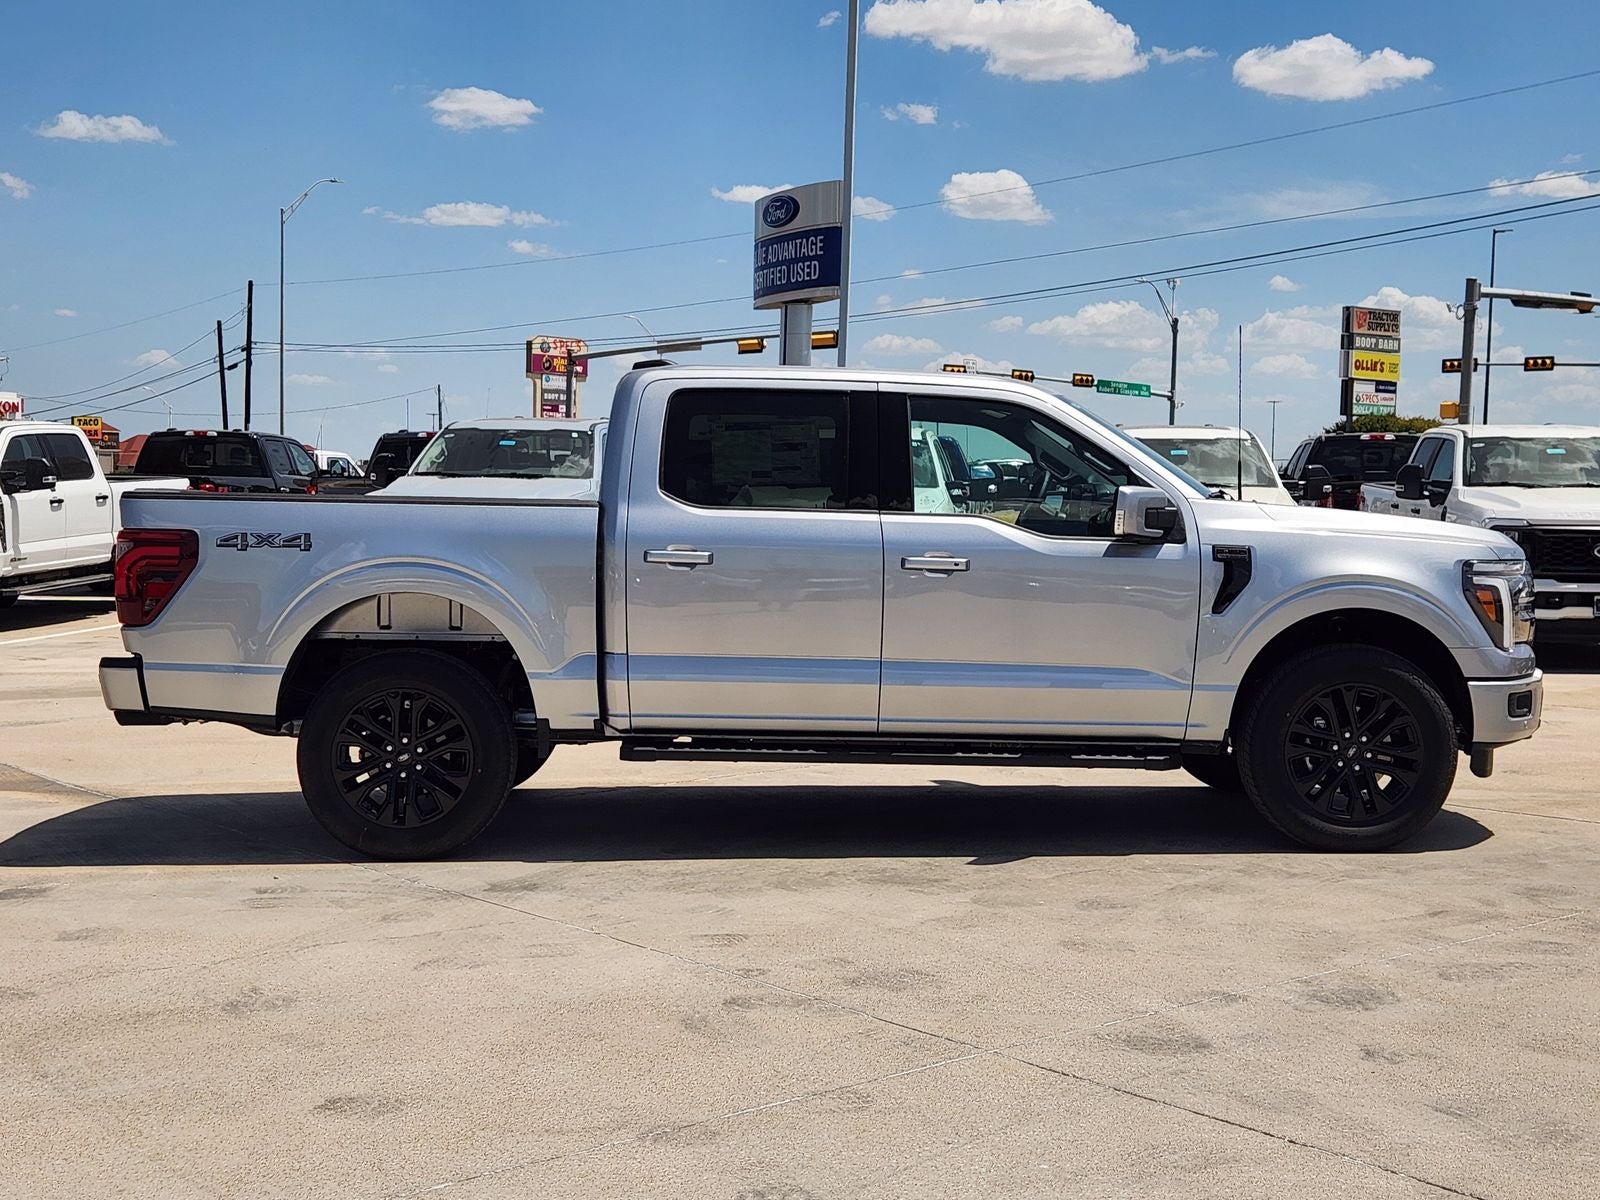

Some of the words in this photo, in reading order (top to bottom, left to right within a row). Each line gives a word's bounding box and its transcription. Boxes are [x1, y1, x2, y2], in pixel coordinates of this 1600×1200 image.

[767, 201, 787, 222] Ford
[767, 236, 824, 264] ADVANTAGE
[790, 261, 819, 283] USED
[1368, 311, 1399, 323] TRACTOR
[1367, 321, 1391, 333] SUPPLY
[1355, 336, 1377, 348] BOOT
[1378, 338, 1399, 350] BARN
[1354, 359, 1385, 373] OLLIE'S
[77, 418, 99, 426] TACO
